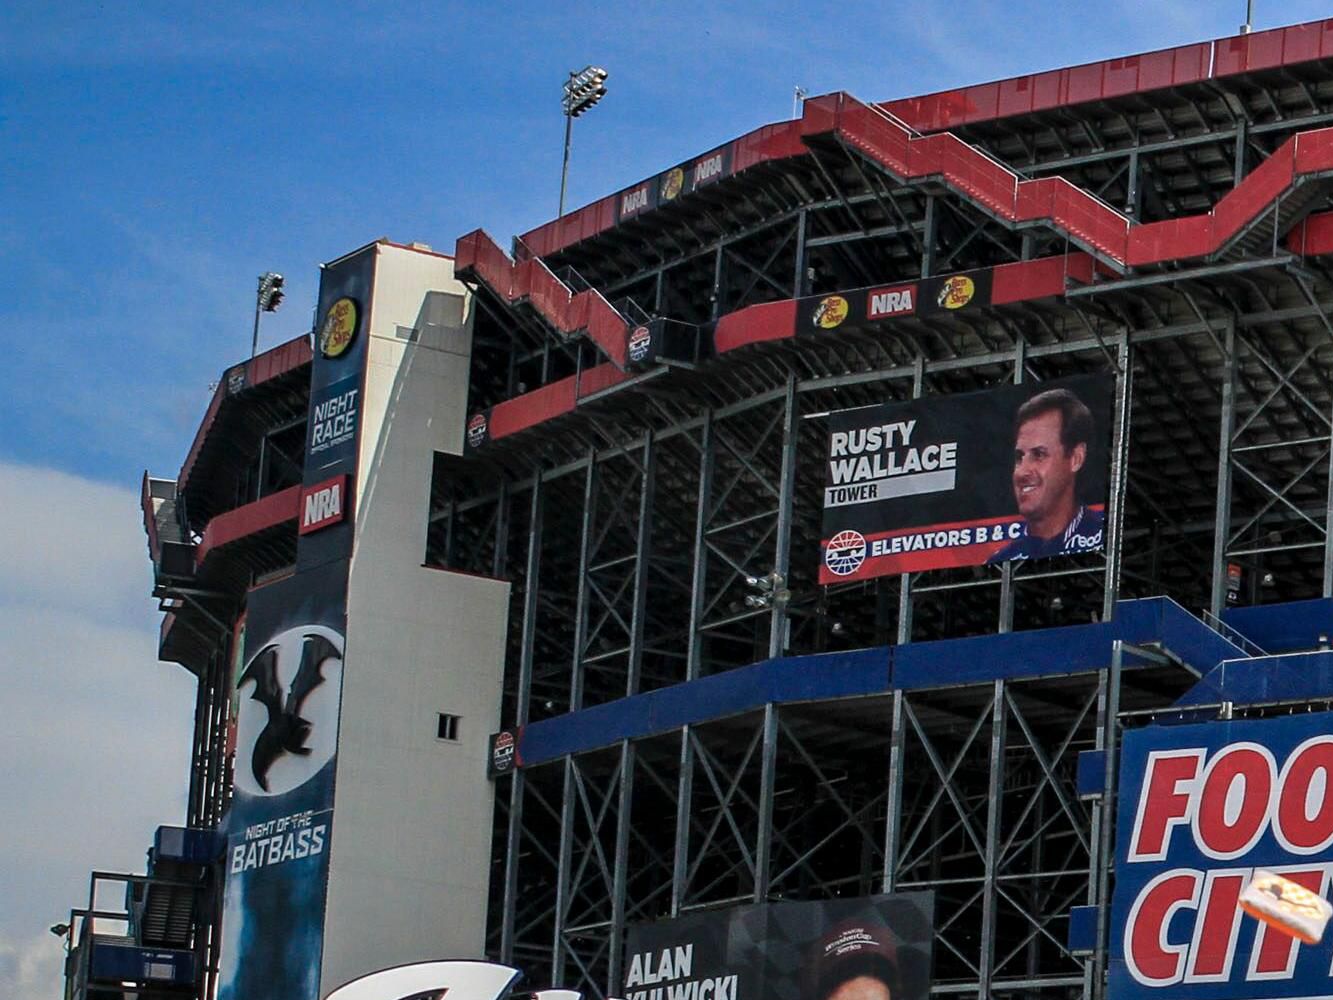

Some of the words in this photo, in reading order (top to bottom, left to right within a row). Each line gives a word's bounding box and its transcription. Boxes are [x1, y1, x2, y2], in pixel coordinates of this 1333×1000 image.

[871, 290, 912, 315] NRA
[314, 390, 358, 424] NIGHT
[312, 410, 356, 446] RACE
[830, 420, 917, 457] RUSTY
[829, 442, 957, 485] WALLACE
[304, 484, 340, 527] NRA
[829, 484, 878, 504] TOWER
[871, 528, 971, 557] ELEVATORS
[976, 527, 987, 543] B
[993, 525, 1004, 541] &
[1009, 523, 1021, 538] C
[245, 820, 276, 840] NIGHT
[276, 816, 291, 832] OF
[292, 810, 313, 828] THE
[231, 825, 326, 874] BATBASS
[626, 944, 693, 988] ALAN
